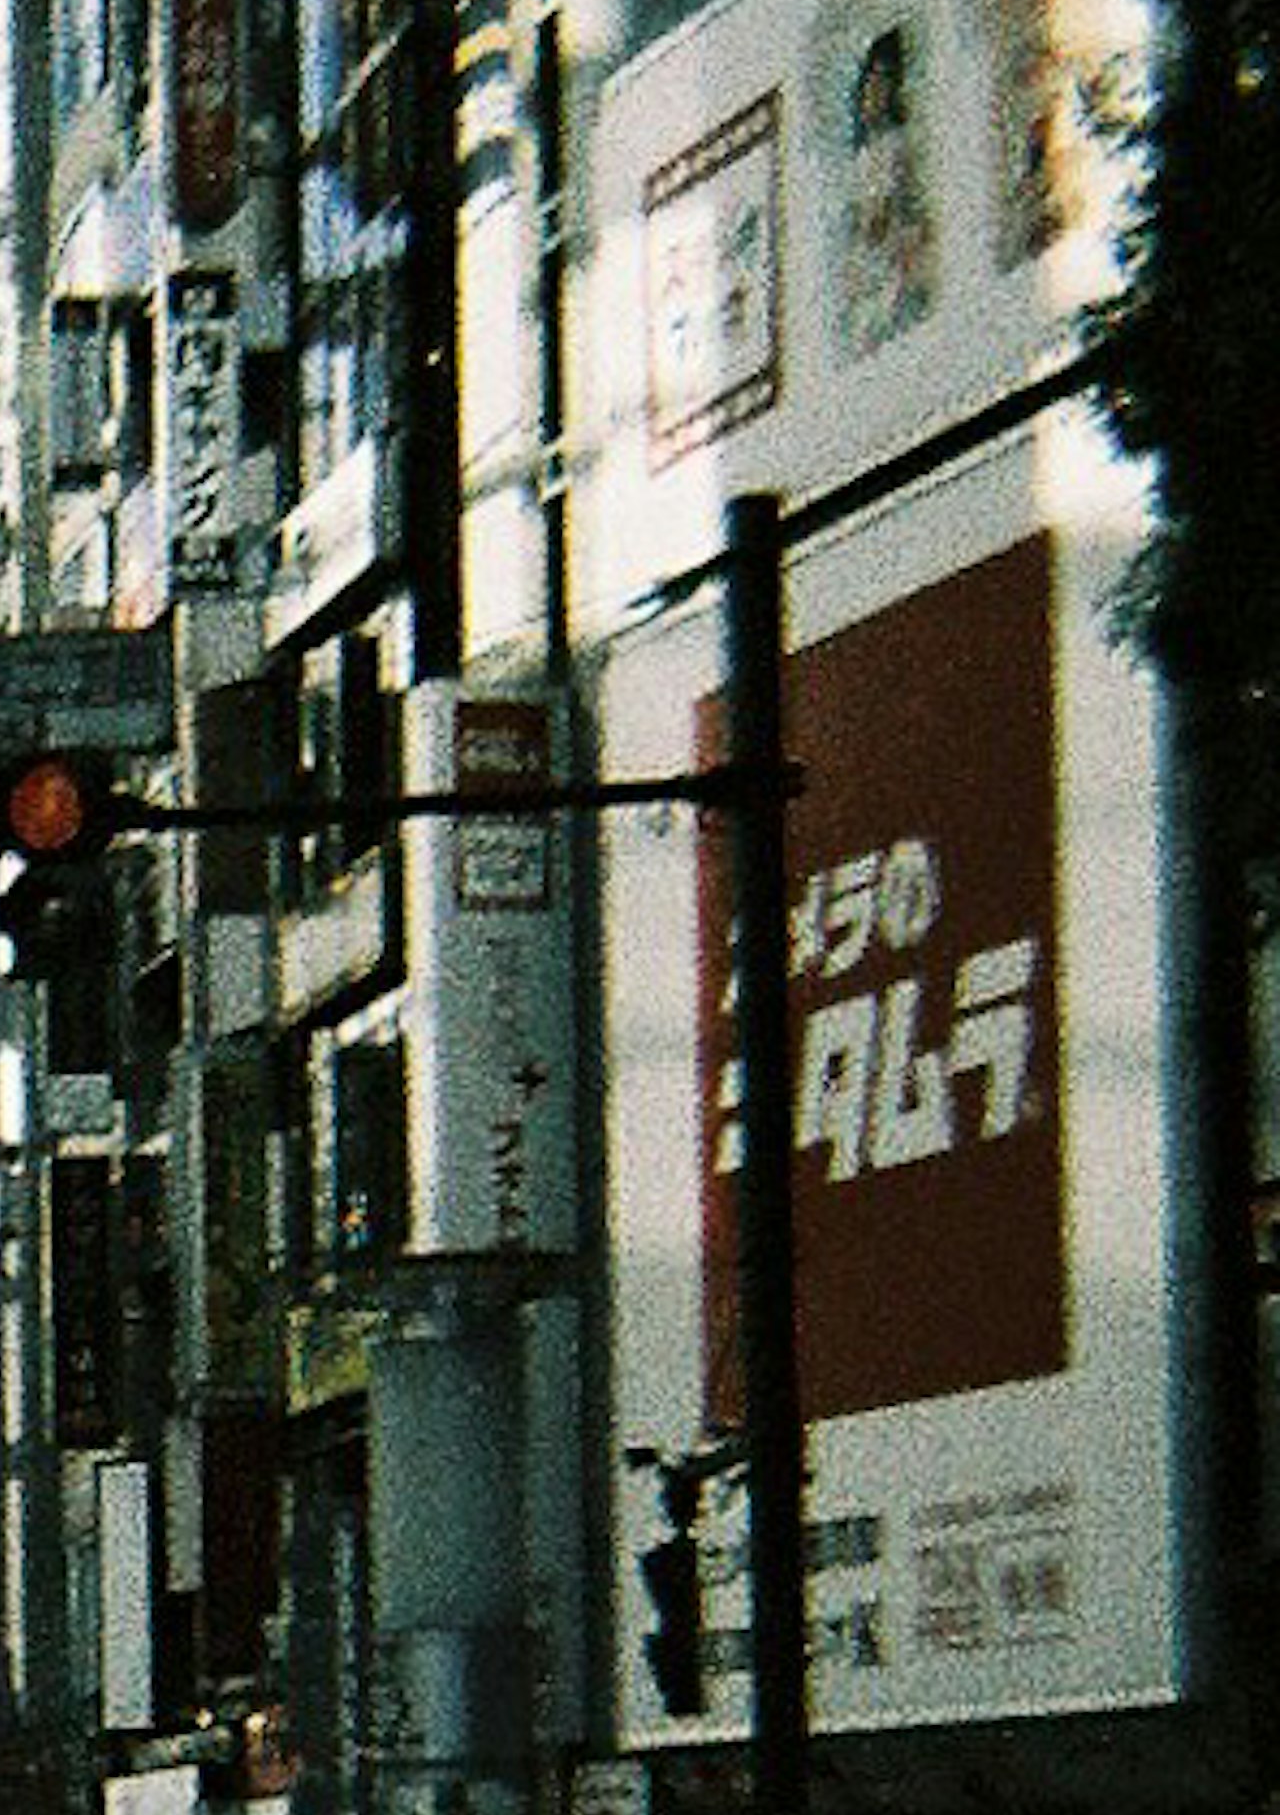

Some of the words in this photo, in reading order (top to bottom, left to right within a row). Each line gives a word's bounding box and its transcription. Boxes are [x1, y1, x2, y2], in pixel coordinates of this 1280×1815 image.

[722, 838, 939, 1015] メラの
[716, 938, 1039, 1183] タムラ
